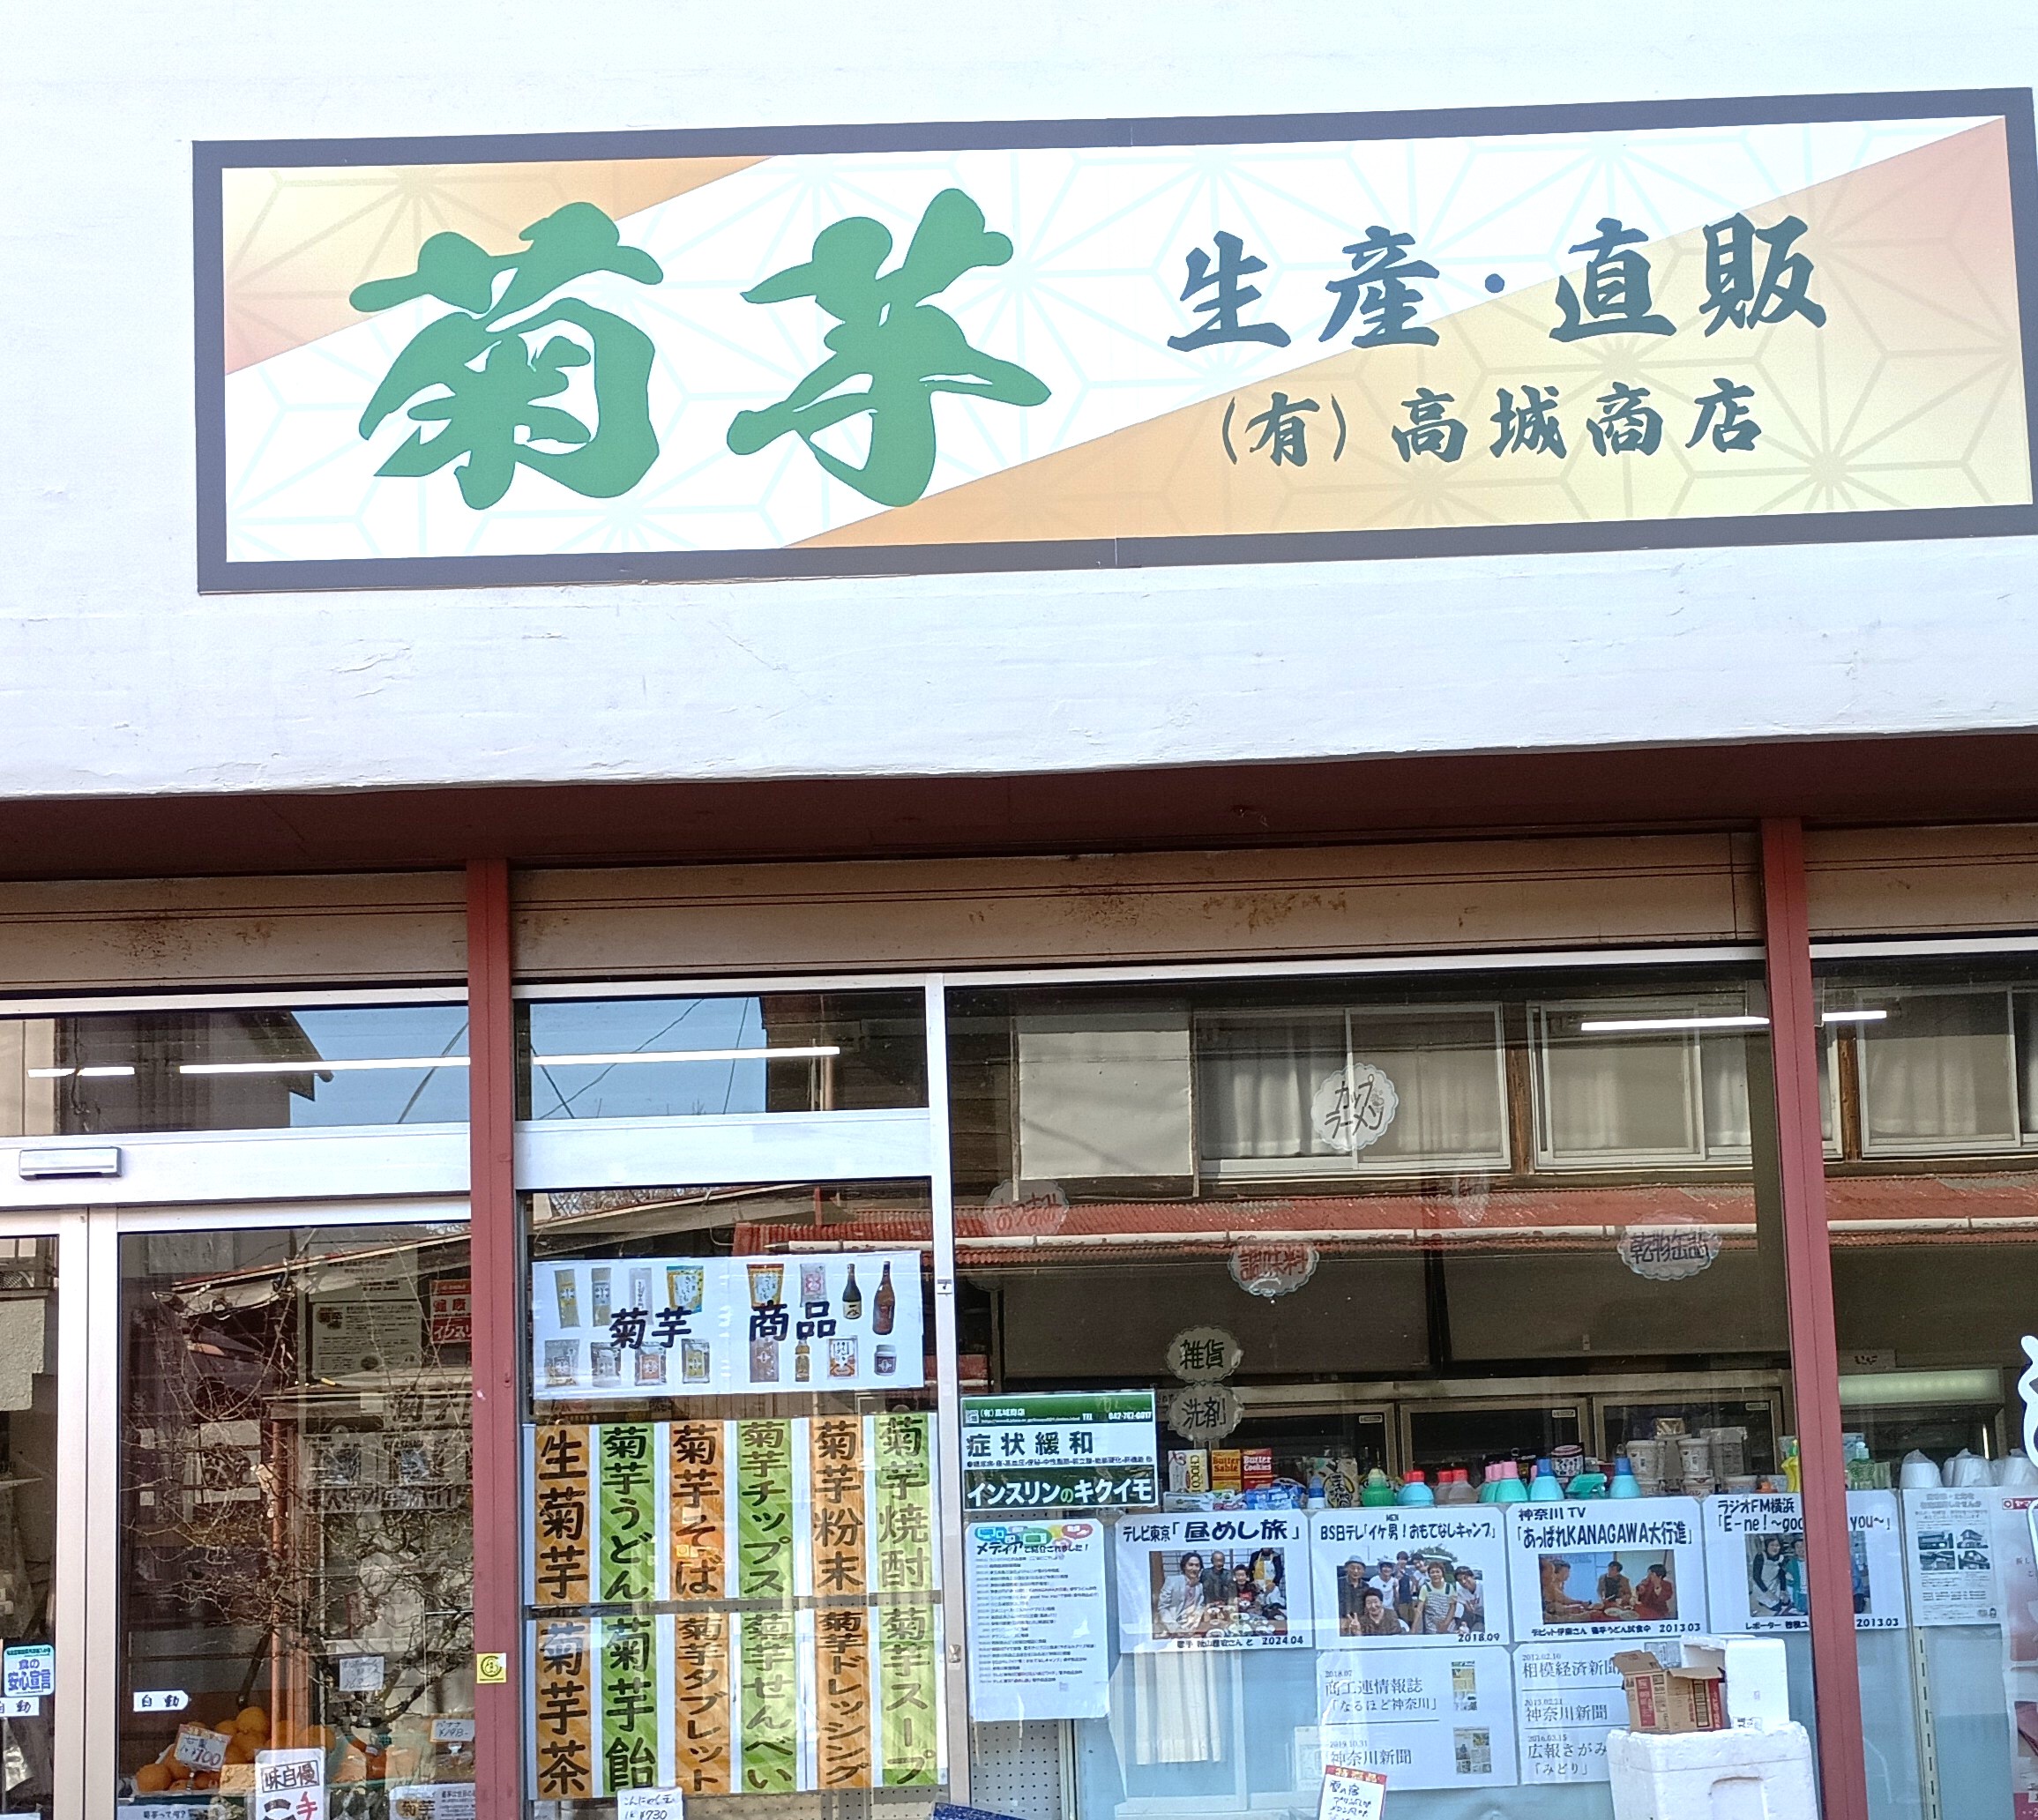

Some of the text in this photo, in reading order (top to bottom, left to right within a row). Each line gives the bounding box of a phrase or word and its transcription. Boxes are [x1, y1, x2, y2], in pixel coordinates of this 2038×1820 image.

[1167, 213, 1827, 351] 生産・直販
[350, 189, 1051, 509] 菊芋
[1335, 1074, 1374, 1111] カップ
[609, 1300, 837, 1349] 菊芋 商品
[1180, 1339, 1224, 1369] 雑貨
[1182, 1397, 1226, 1428] 洗剤
[967, 1431, 1093, 1457] 症状緩和
[538, 1429, 588, 1599] 生菊芋
[602, 1426, 654, 1600] 菊芋うどん
[672, 1424, 722, 1594] 菊芋そば
[741, 1421, 791, 1594] 菊芋チップス
[813, 1420, 864, 1591] 菊芋粉末
[877, 1416, 929, 1588] 菊芋焼酎
[967, 1479, 1152, 1506] インスリンのキクイモ
[1718, 1498, 1795, 1514] ラジオFM横浜
[1518, 1521, 1691, 1548] 「あっぱれKANAGAWA大行進」
[1458, 1633, 1500, 1643] 2018.09
[8, 1669, 50, 1690] 安心宣言
[141, 1694, 179, 1708] 自動
[743, 1613, 793, 1789] 菊芋せんべい
[818, 1610, 870, 1785] 菊芋ドレッシング
[882, 1607, 935, 1785] 菊芋スープ
[539, 1622, 587, 1794] 菊芋茶
[605, 1617, 654, 1791] 菊芋飴
[677, 1617, 728, 1791] 菊芋タブレット
[1333, 1697, 1437, 1712] 「なるほど神奈川」
[1527, 1704, 1608, 1721] 神奈川新聞
[265, 1763, 317, 1789] 味自慢
[1330, 1749, 1412, 1766] 神奈川新聞
[1536, 1762, 1587, 1775] 「みどり」
